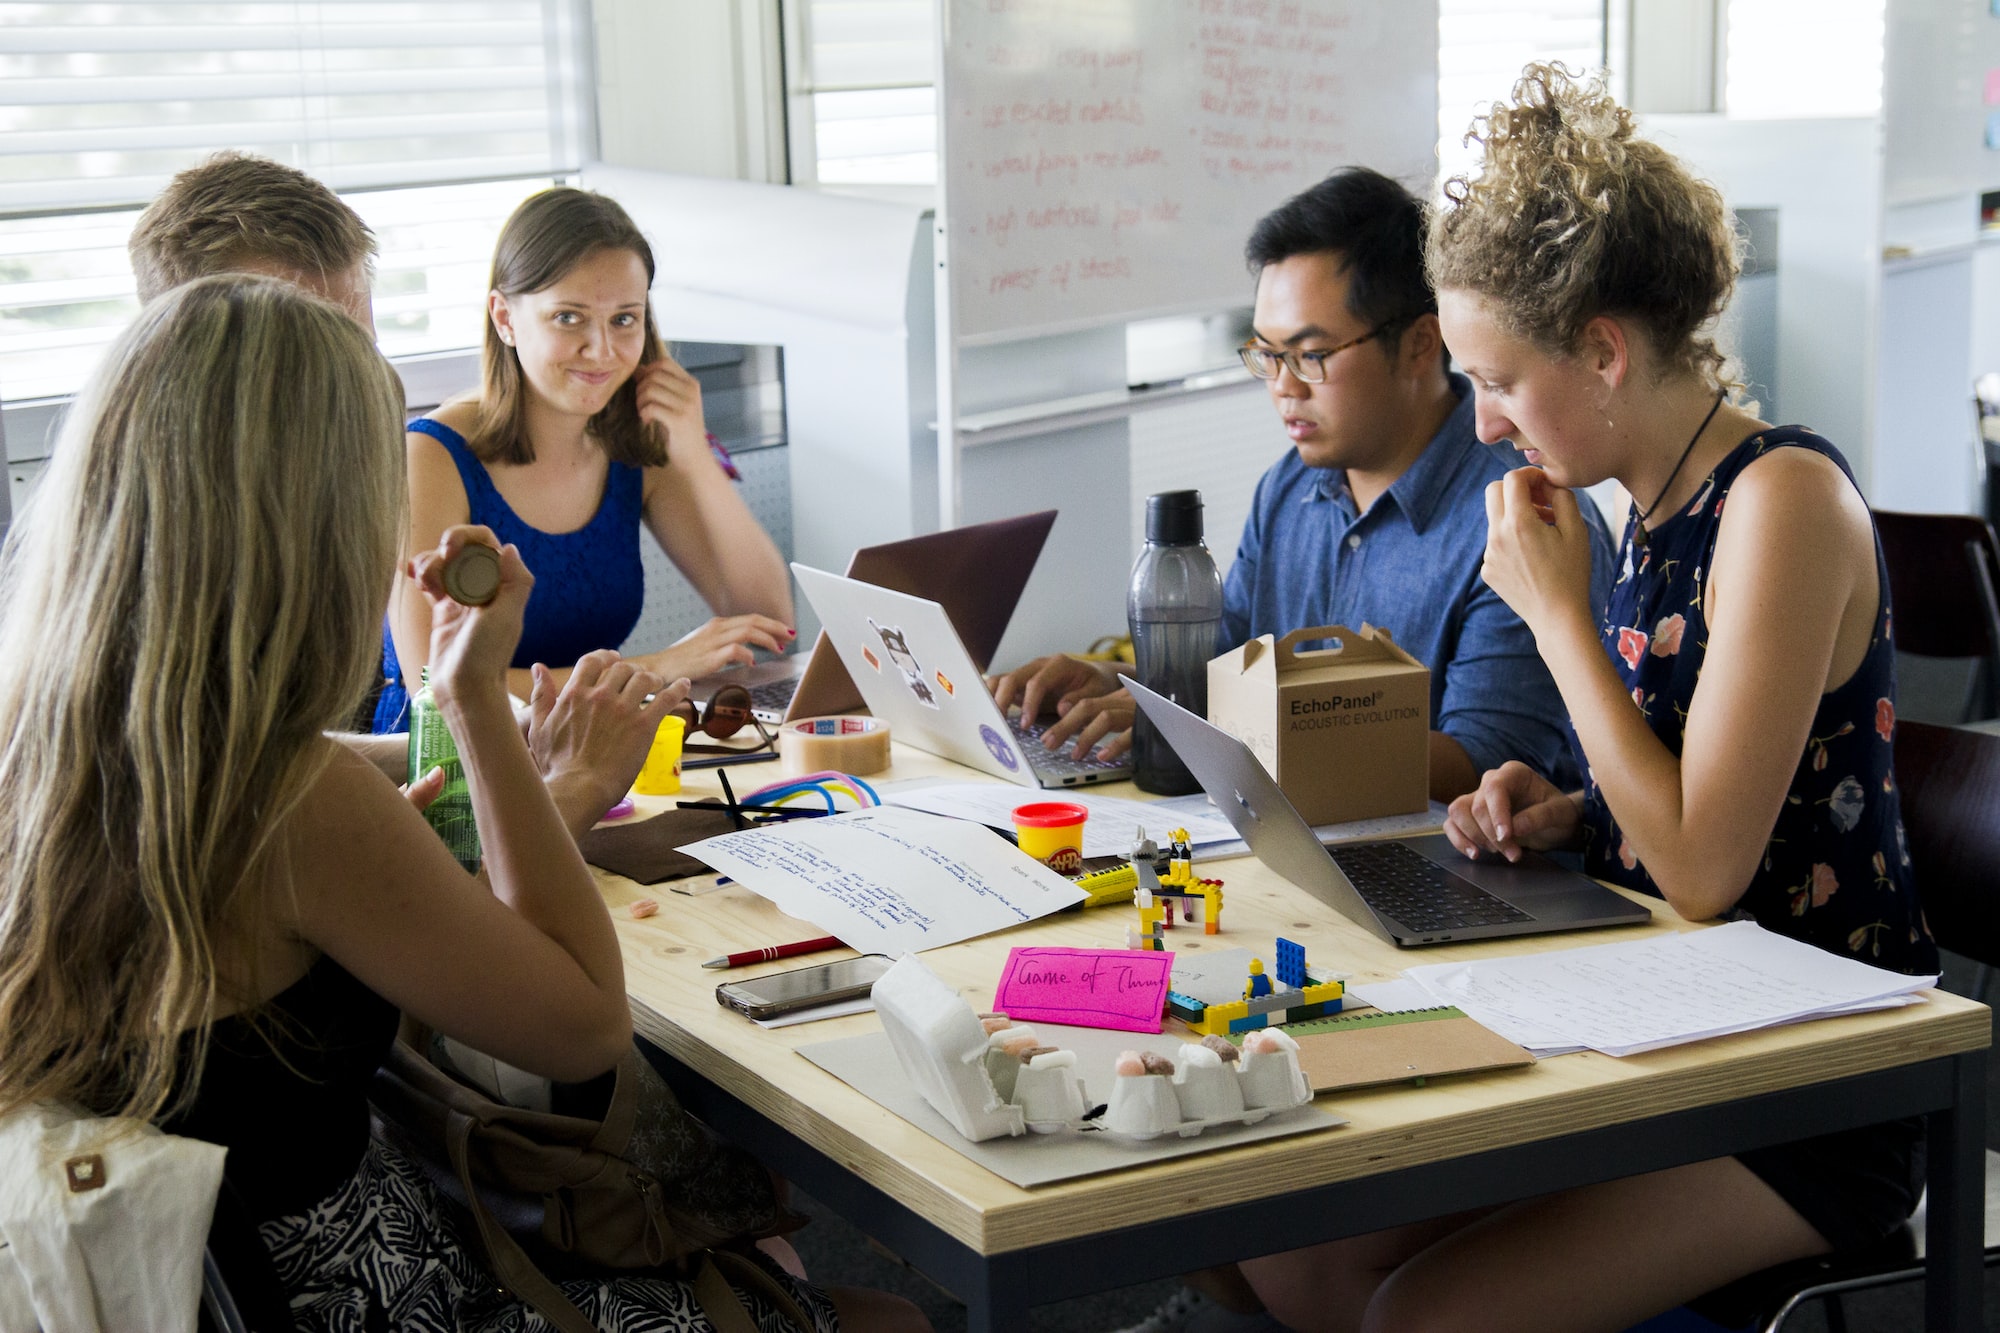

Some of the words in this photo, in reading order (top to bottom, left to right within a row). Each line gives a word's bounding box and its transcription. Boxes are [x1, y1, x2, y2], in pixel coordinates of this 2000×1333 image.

[1290, 714, 1351, 732] ACOUSTIC
[1354, 707, 1420, 725] EVOLUTION
[422, 727, 432, 758] Komm
[1018, 960, 1071, 985] Game
[1081, 956, 1104, 993] of
